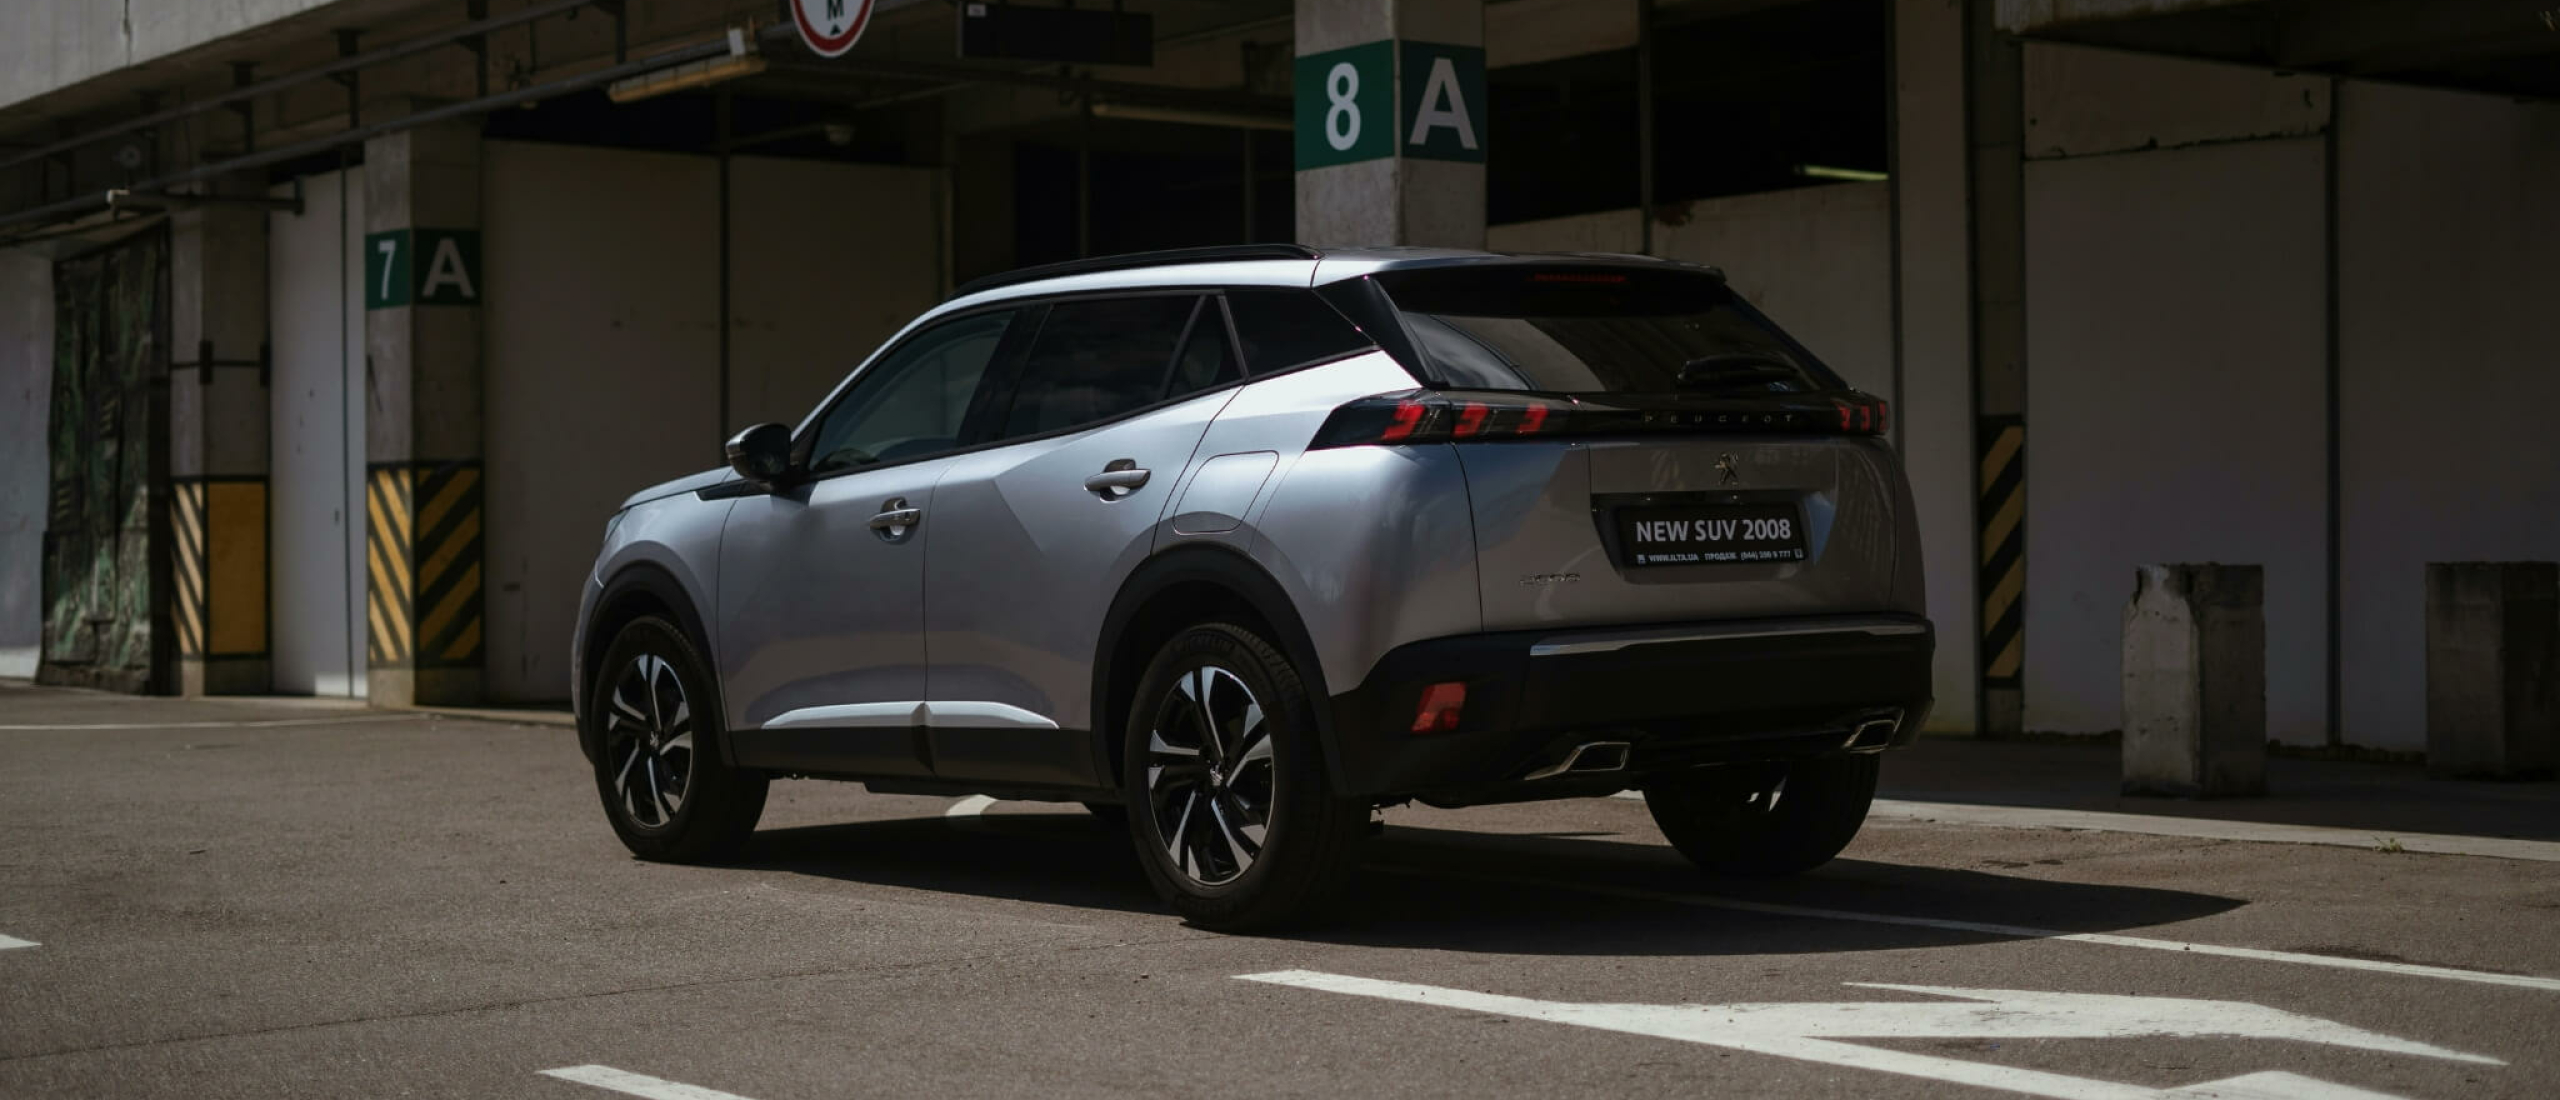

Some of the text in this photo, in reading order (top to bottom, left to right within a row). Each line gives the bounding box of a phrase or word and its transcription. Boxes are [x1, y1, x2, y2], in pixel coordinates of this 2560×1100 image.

[1325, 61, 1361, 151] 8
[1408, 57, 1478, 151] A
[377, 239, 397, 299] 7
[421, 237, 476, 298] A
[1635, 517, 1792, 542] NEW SUV 2008
